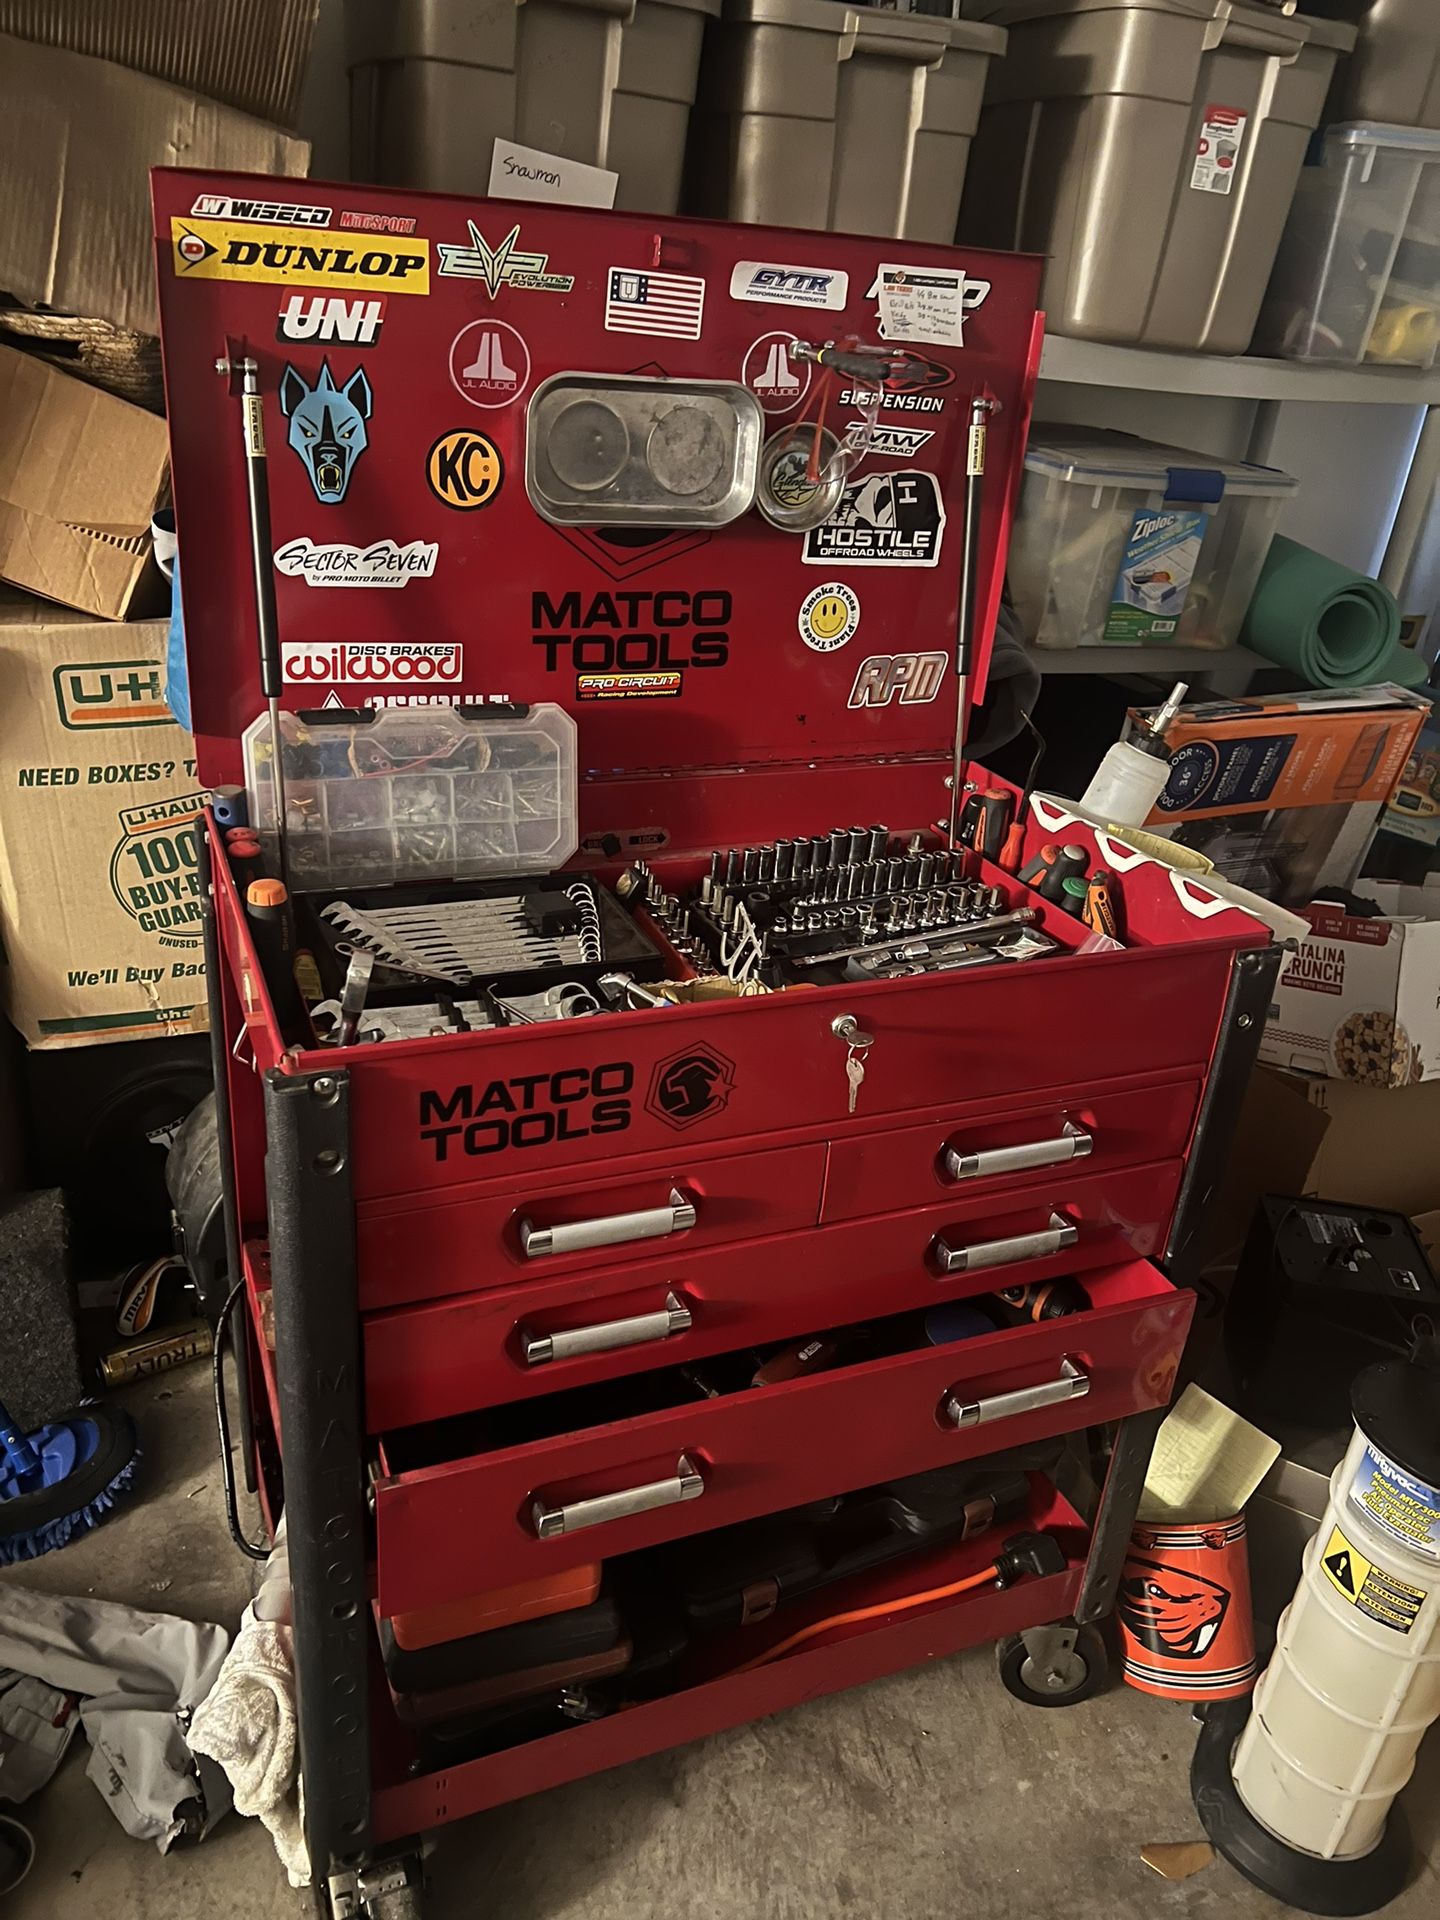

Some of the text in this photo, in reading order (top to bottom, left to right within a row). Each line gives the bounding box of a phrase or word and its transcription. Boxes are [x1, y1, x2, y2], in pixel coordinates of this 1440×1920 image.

[221, 240, 426, 278] DUNLOP
[512, 273, 572, 284] EVOLUTION
[751, 268, 832, 292] GYTR
[746, 290, 827, 304] PERFORMANCE PRODUCTS
[283, 296, 382, 342] UNI
[463, 380, 517, 391] JL AUDIO
[767, 388, 800, 396] AUDIO
[839, 391, 944, 412] SUSPENSION
[438, 442, 490, 501] KC
[817, 528, 932, 548] HOSTILE
[1131, 515, 1176, 542] Ziploc
[820, 547, 924, 557] OFFROAD WHEELS
[312, 574, 322, 582] by
[532, 591, 733, 629] MATCO
[802, 585, 858, 616] Smoke Trees
[803, 624, 855, 650] Plant Trees
[285, 645, 462, 680] wilwood
[348, 646, 455, 656] DISC BRAKES
[533, 632, 729, 672] TOOLS
[581, 676, 679, 690] PRO CIRCUIT
[849, 652, 948, 707] RPM
[626, 690, 678, 698] Development
[18, 768, 80, 787] NEED
[88, 761, 176, 785] BOXES?
[1296, 943, 1346, 965] TALINA
[125, 967, 165, 984] Buy
[171, 962, 208, 978] Bac
[420, 1061, 634, 1126] MATCO
[420, 1100, 632, 1162] TOOLS
[134, 1342, 202, 1377] TRULY
[1372, 1471, 1399, 1496] Model
[1361, 1492, 1383, 1514] Fluid
[1382, 1511, 1436, 1544] Evacuator
[1384, 1503, 1430, 1533] Operated
[1377, 1570, 1420, 1595] WARNING!
[1367, 1582, 1417, 1610] ATTENTION!
